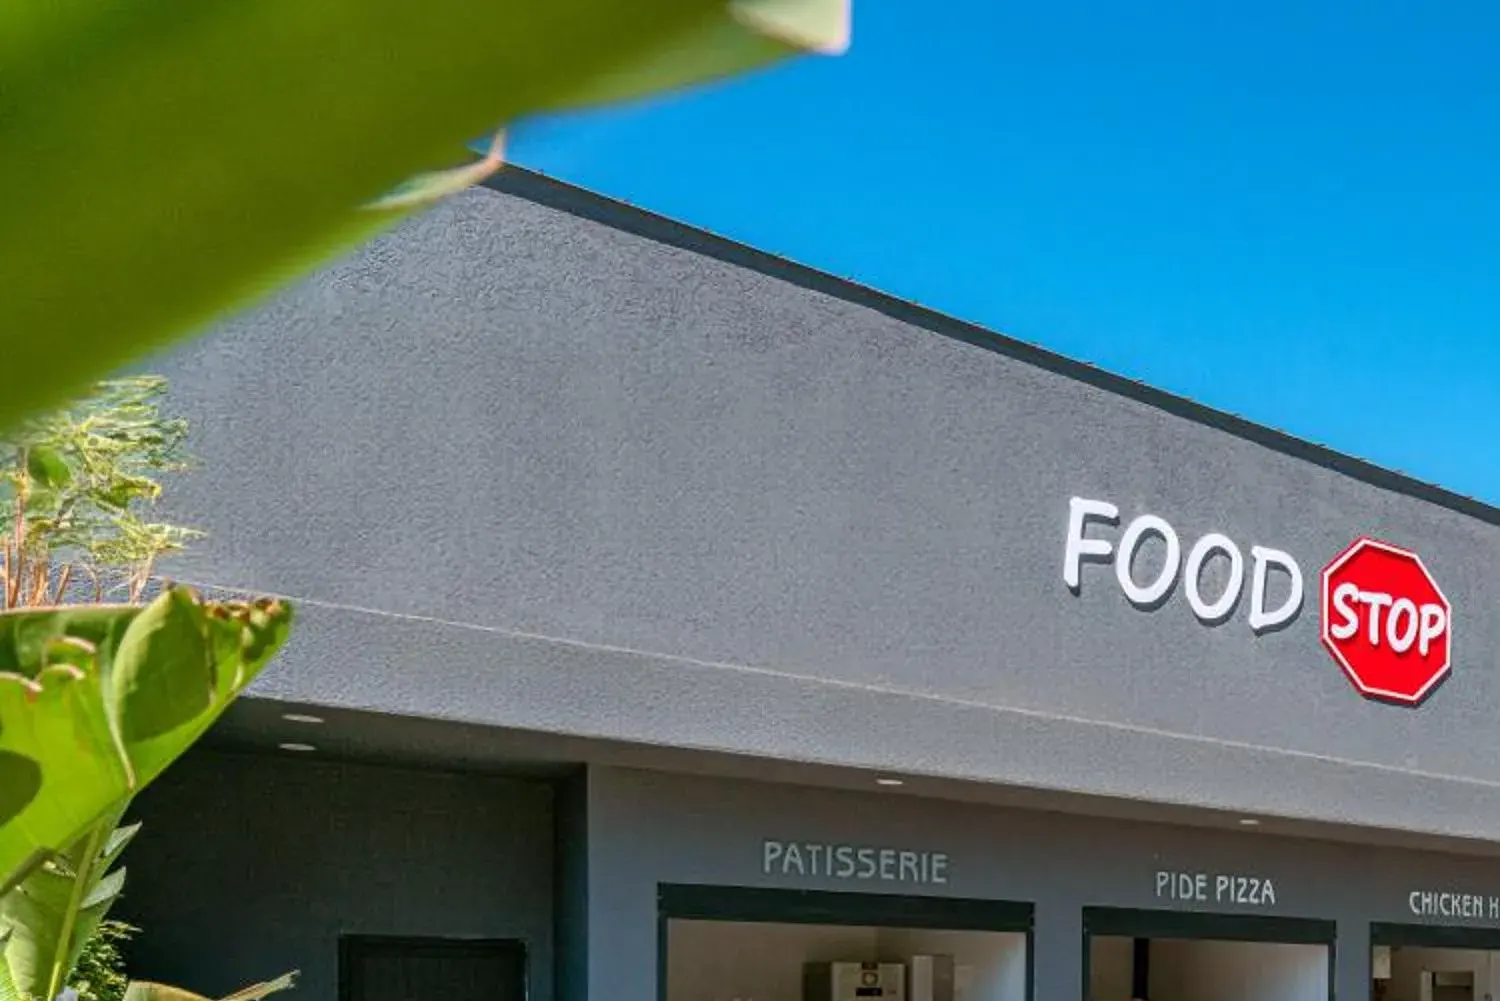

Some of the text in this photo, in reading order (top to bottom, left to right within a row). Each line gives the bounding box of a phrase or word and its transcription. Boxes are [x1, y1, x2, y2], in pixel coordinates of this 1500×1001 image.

[1063, 496, 1446, 657] FOOD STOP
[764, 840, 948, 883] PATISSERIE
[1156, 871, 1275, 905] PIDE PIZZA
[1409, 890, 1483, 918] CHICKEN
